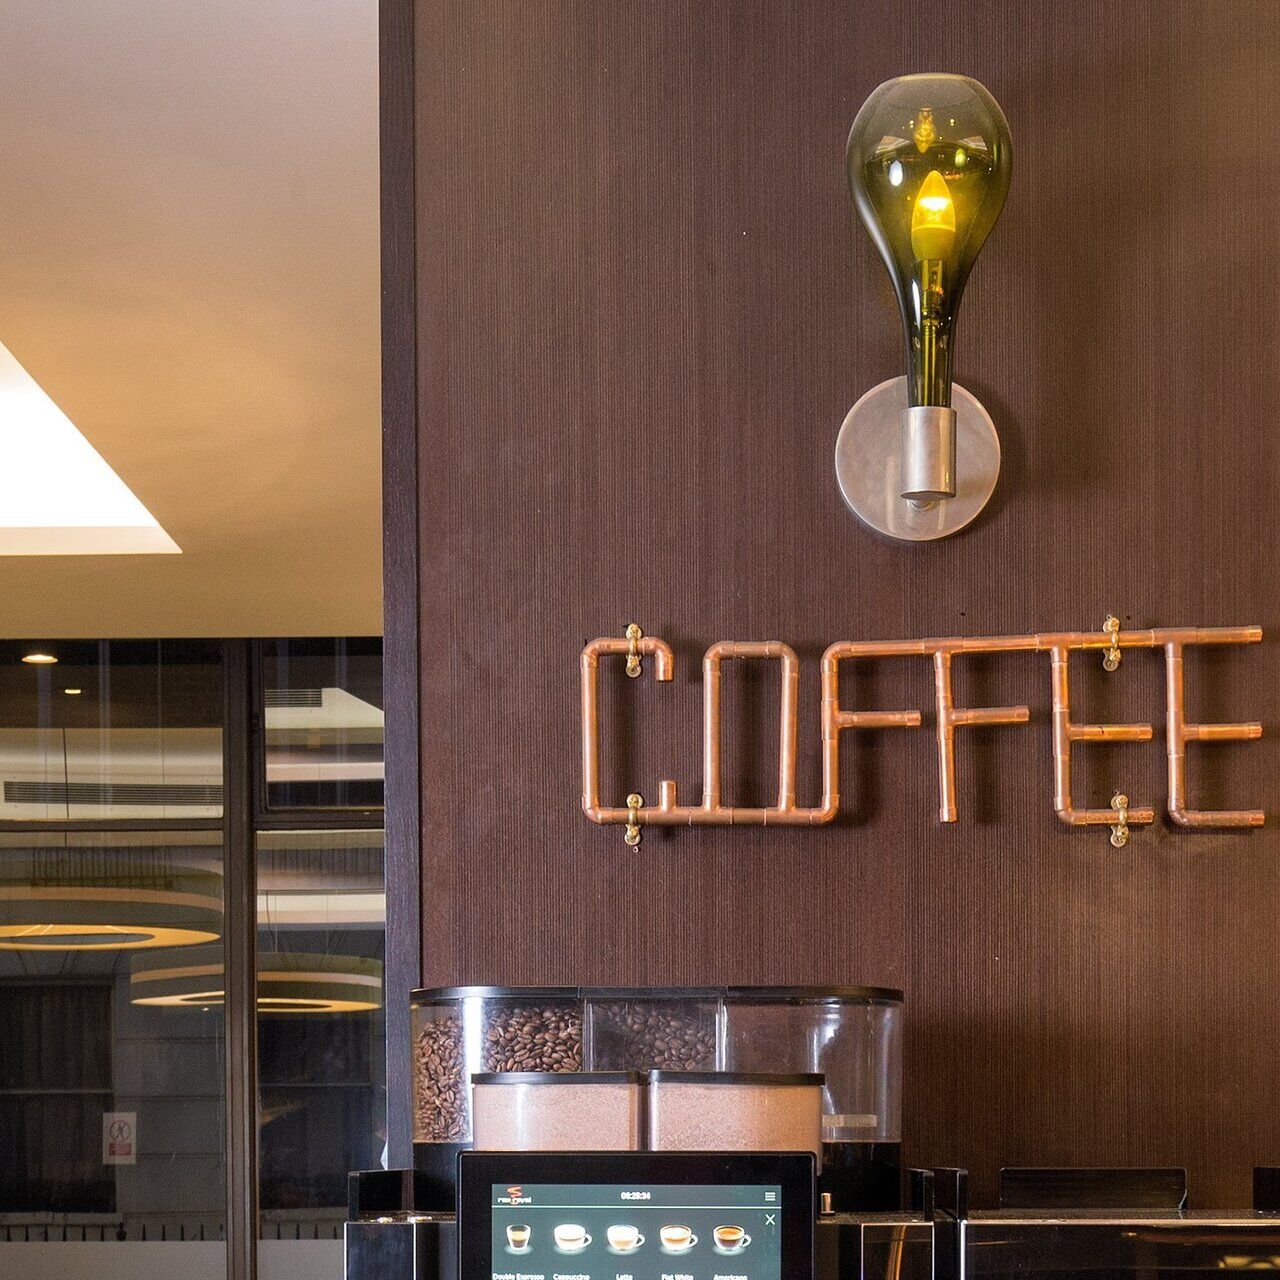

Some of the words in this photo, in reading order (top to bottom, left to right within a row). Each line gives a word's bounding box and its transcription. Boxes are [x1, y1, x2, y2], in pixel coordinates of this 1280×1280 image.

[580, 623, 1265, 827] COFFEE
[492, 1273, 515, 1280] Double
[616, 1273, 633, 1280] Latte
[661, 1273, 674, 1280] Flat
[675, 1273, 694, 1280] White
